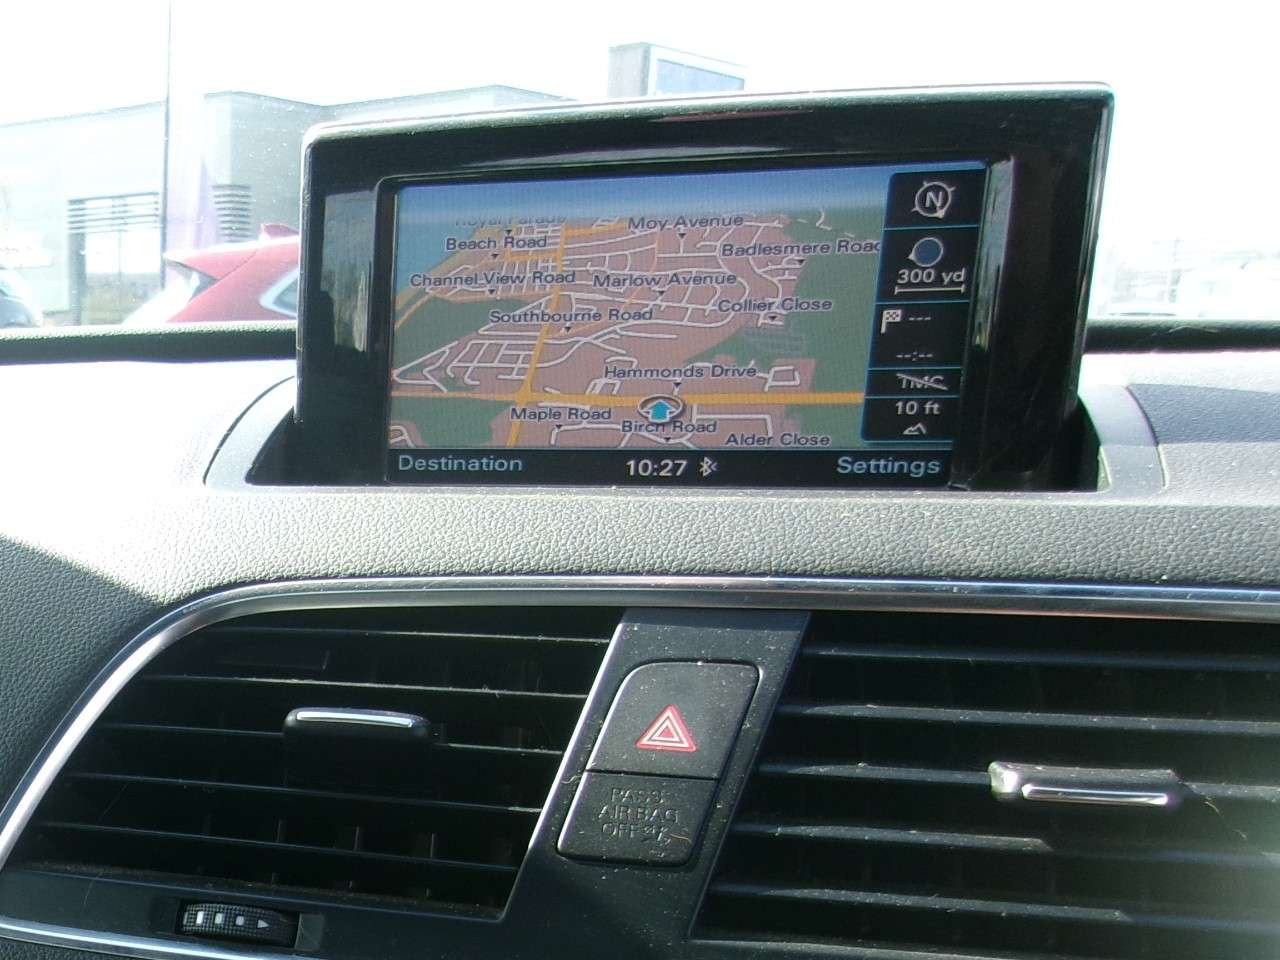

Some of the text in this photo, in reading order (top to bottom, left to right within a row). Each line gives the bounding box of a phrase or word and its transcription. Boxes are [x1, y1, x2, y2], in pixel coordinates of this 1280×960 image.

[628, 214, 743, 231] Moy Avenue
[446, 235, 548, 251] Beach Road
[721, 242, 831, 258] Badlesmere
[410, 271, 576, 288] Channel View Road
[592, 272, 737, 288] Marlow Avenue
[897, 268, 966, 284] 300 yd
[718, 298, 832, 313] Collier Close
[489, 309, 653, 325] Southbourne Road
[604, 364, 757, 379] Hammonds Drive
[510, 406, 612, 423] Maple Road
[895, 401, 941, 416] 10 ft
[621, 419, 717, 434] Birch Road
[725, 432, 830, 447] Alder Close
[398, 454, 523, 472] Destination
[626, 459, 687, 477] 10:27
[836, 456, 941, 476] Settings
